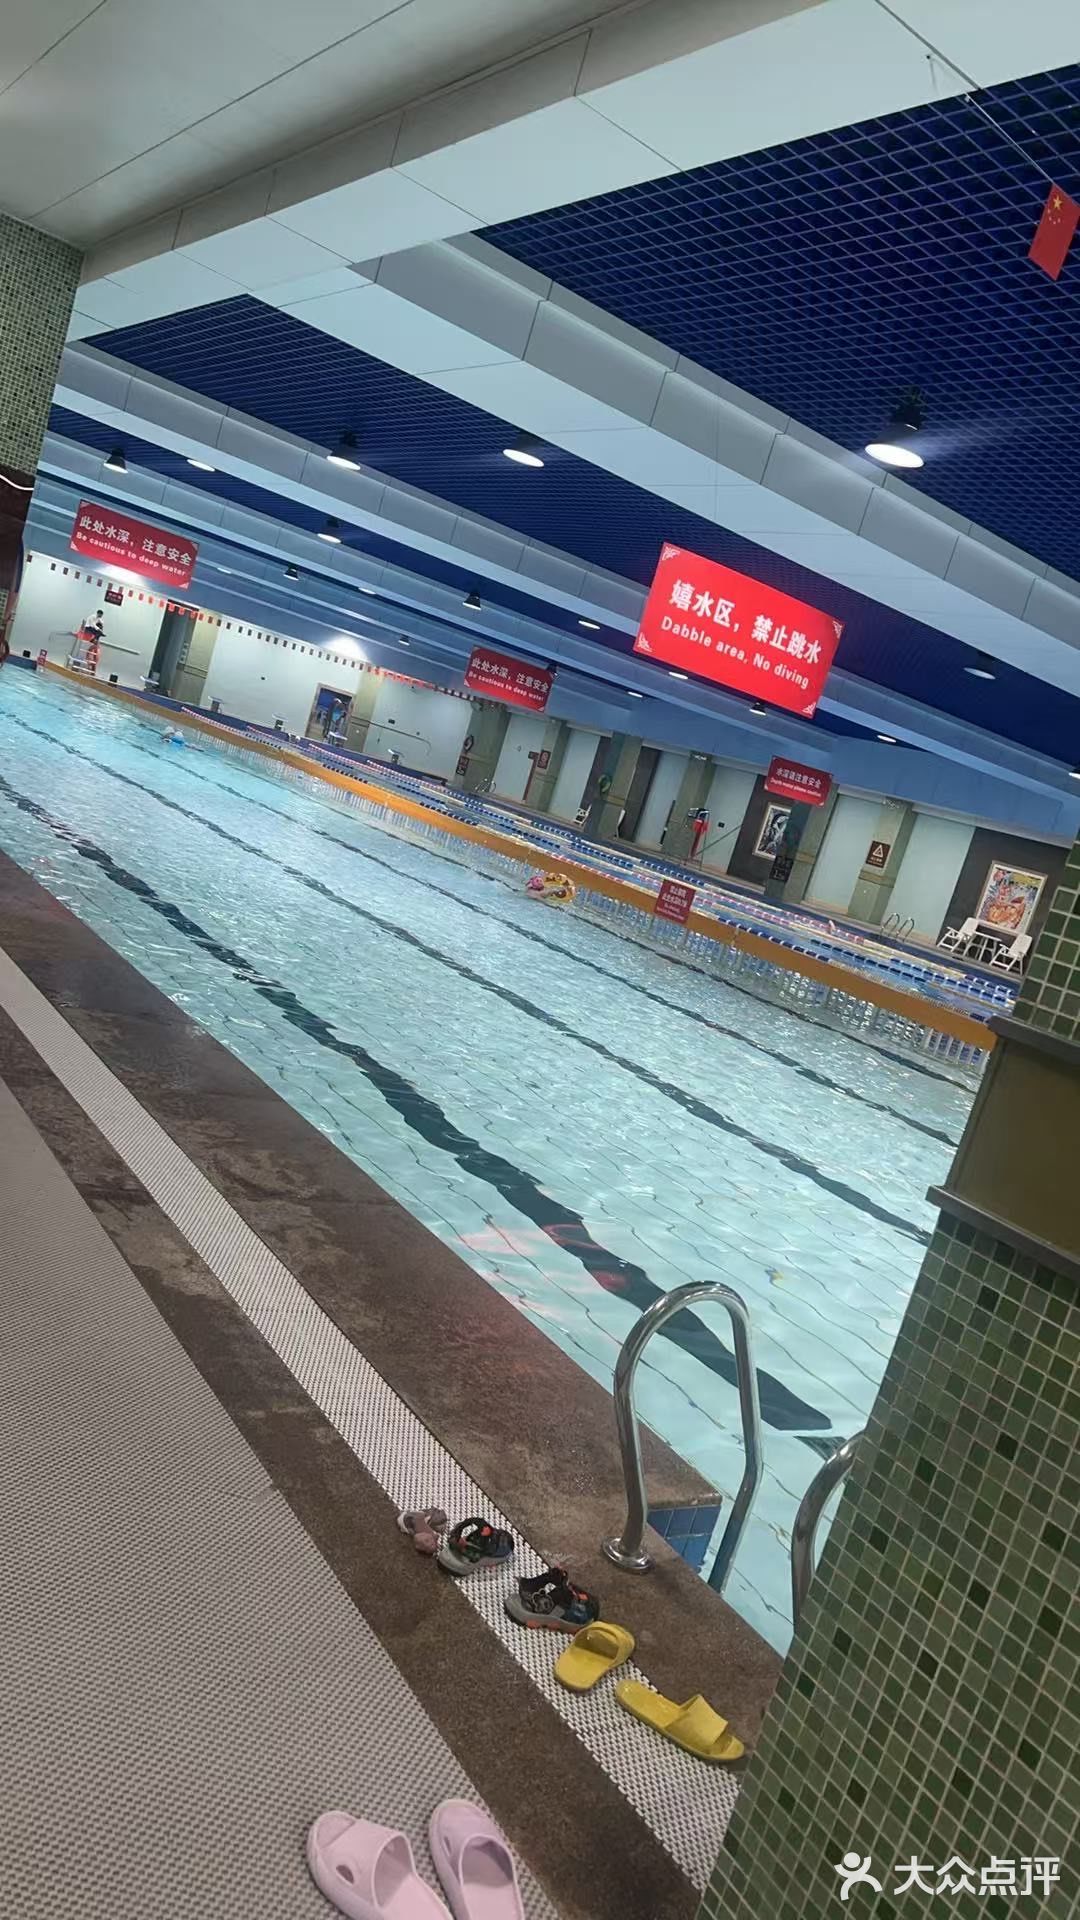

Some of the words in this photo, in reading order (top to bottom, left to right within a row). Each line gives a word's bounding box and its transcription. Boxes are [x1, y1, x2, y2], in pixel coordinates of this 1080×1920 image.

[76, 532, 87, 541] Be
[89, 538, 125, 556] cautious
[127, 551, 137, 559] to
[139, 555, 159, 567] deep
[161, 563, 187, 576] water
[79, 516, 192, 566] 此处水深，注意安全
[669, 579, 822, 665] 嬉水区，禁止跳水
[471, 657, 549, 692] 此处水深，注意安全
[661, 616, 712, 648] Dabble
[716, 640, 749, 665] area,
[753, 653, 771, 671] No
[774, 662, 809, 690] diving
